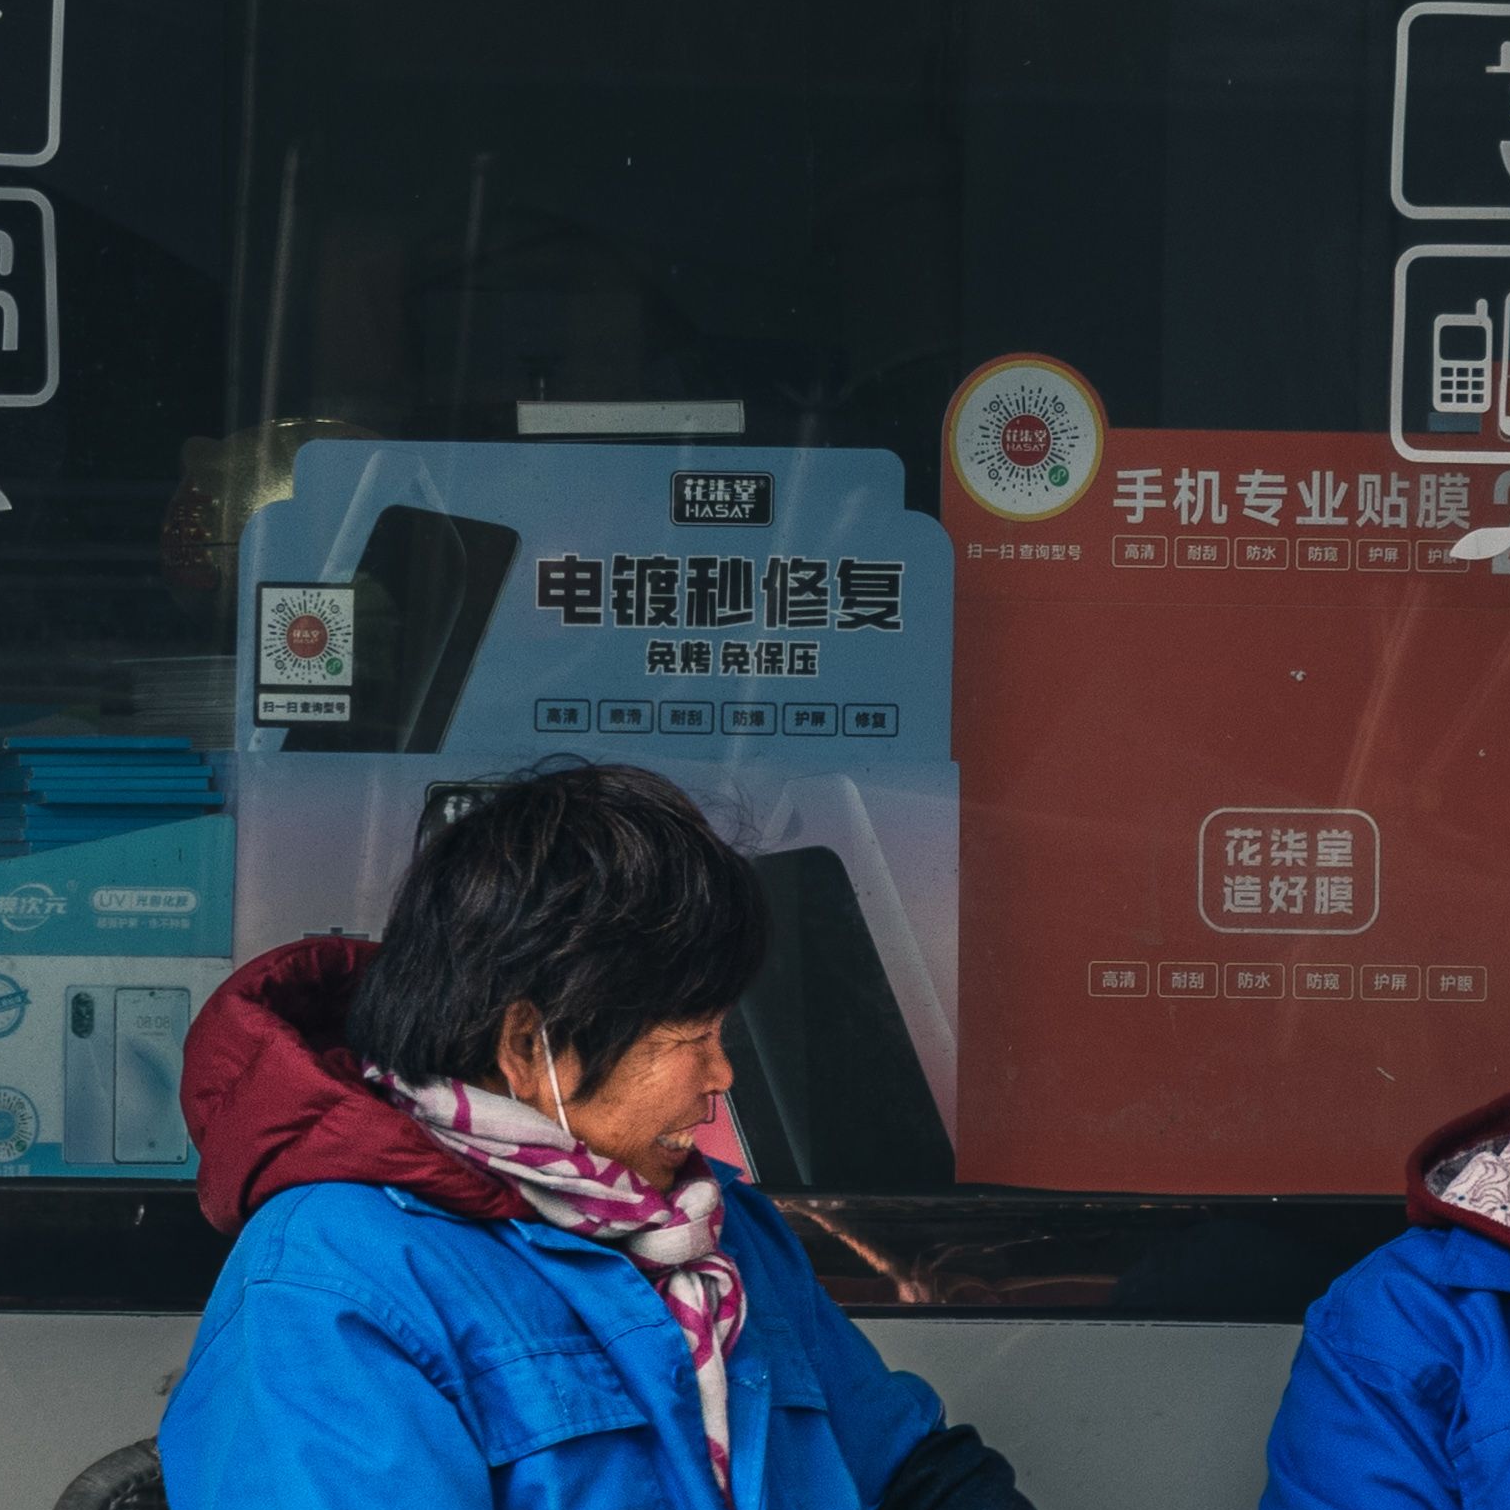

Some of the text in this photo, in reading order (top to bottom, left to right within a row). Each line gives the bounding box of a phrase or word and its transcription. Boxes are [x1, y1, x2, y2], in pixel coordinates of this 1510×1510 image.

[1112, 467, 1471, 531] 手机专业贴膜
[685, 503, 755, 518] HASAT
[967, 544, 1082, 561] 扫一扫 查询型号
[1124, 544, 1155, 560] 高清
[1187, 544, 1218, 561] 耐刮
[1246, 544, 1277, 562] 防水
[1367, 546, 1399, 564] 护屏
[535, 553, 905, 632] 电镀秒修复
[719, 640, 819, 676] 免保压
[263, 702, 298, 713] 扫一扫
[546, 709, 578, 724] 高清
[794, 711, 826, 727] 护屏
[1223, 875, 1354, 915] 造好膜
[1101, 969, 1136, 990] 高清
[1171, 970, 1205, 990] 耐刮
[1237, 970, 1272, 991] 防水
[1373, 972, 1408, 993] 护屏
